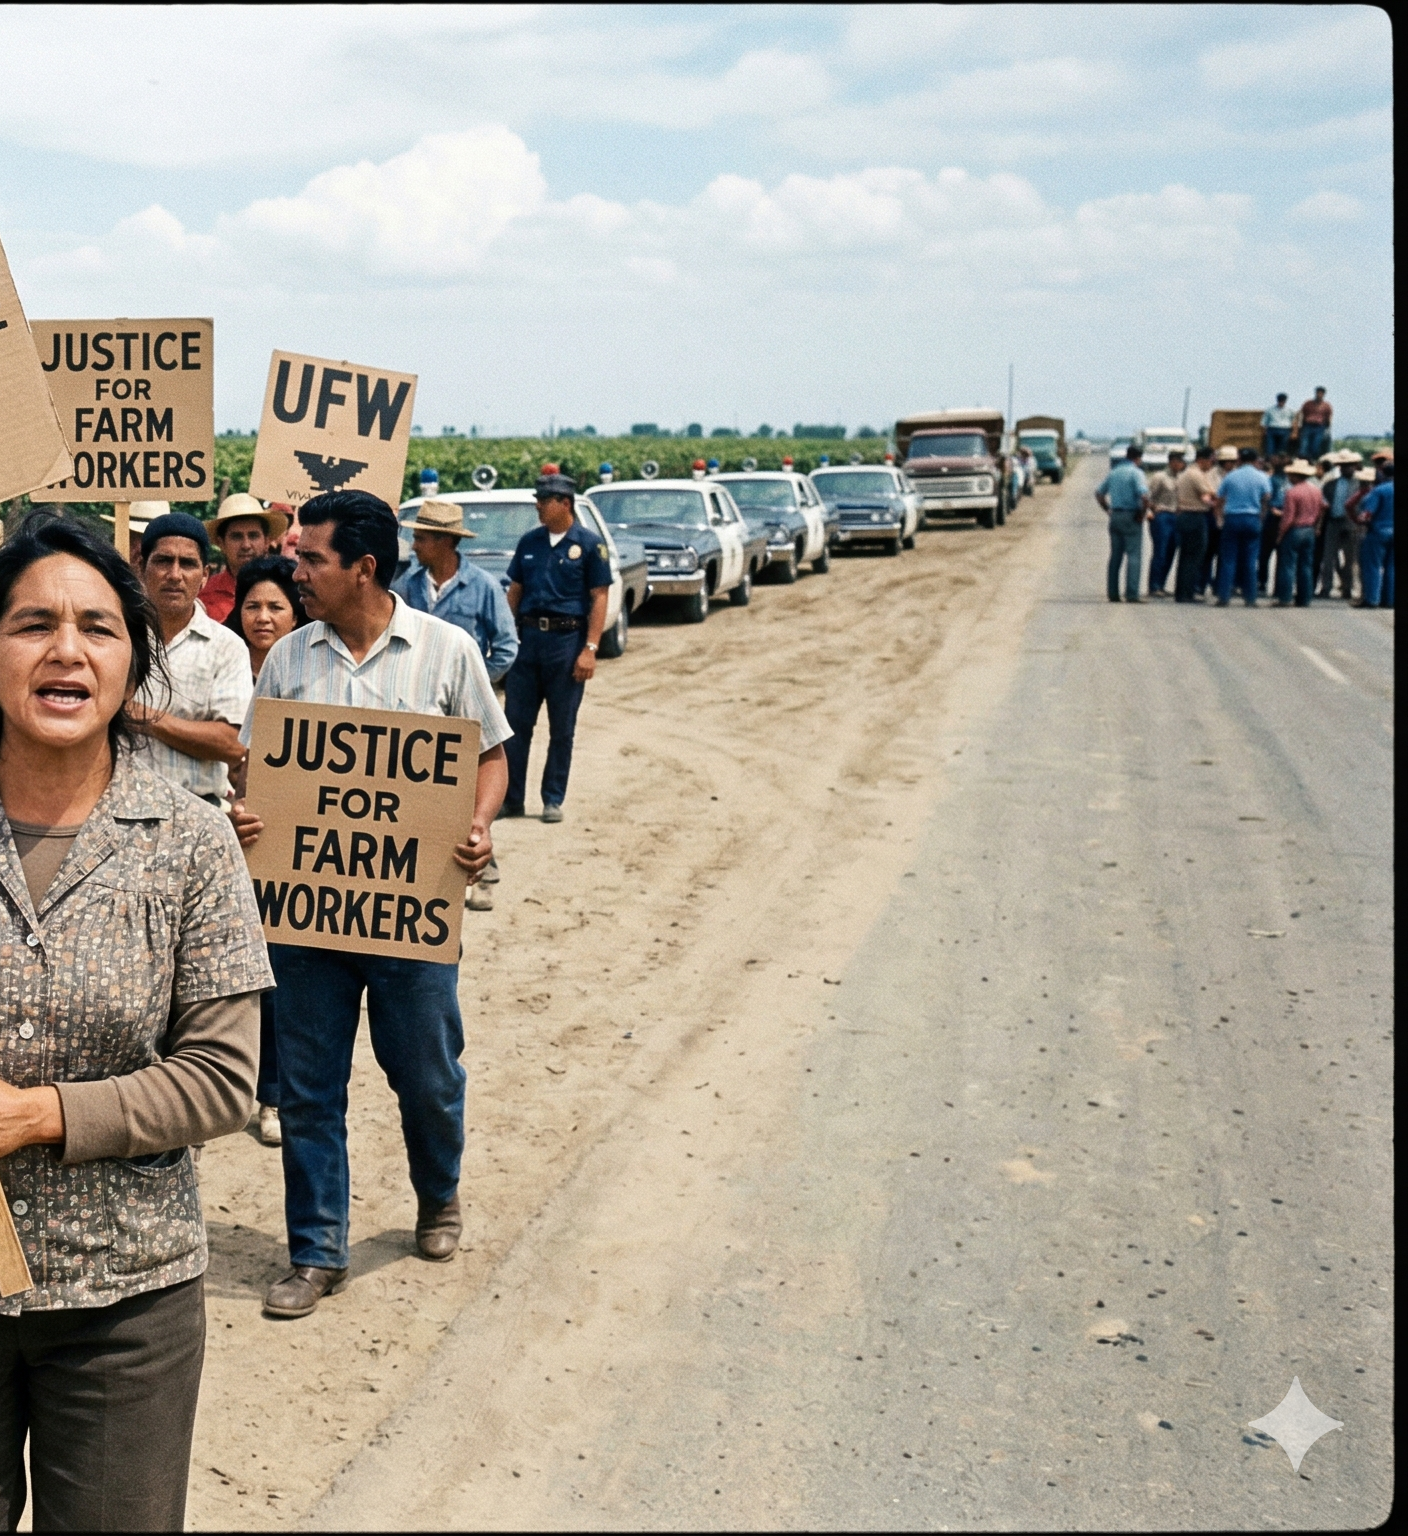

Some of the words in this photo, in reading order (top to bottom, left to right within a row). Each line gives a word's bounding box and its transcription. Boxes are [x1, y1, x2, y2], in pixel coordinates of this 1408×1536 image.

[41, 331, 201, 372] JUSTICE
[95, 378, 152, 401] FOR
[273, 360, 411, 441] UFW
[75, 407, 174, 443] FARM
[46, 450, 207, 489] ORKERS
[263, 717, 462, 786] JUSTICE
[317, 785, 400, 823] FOR
[292, 825, 419, 884] FARM
[253, 878, 450, 946] WORKERS
